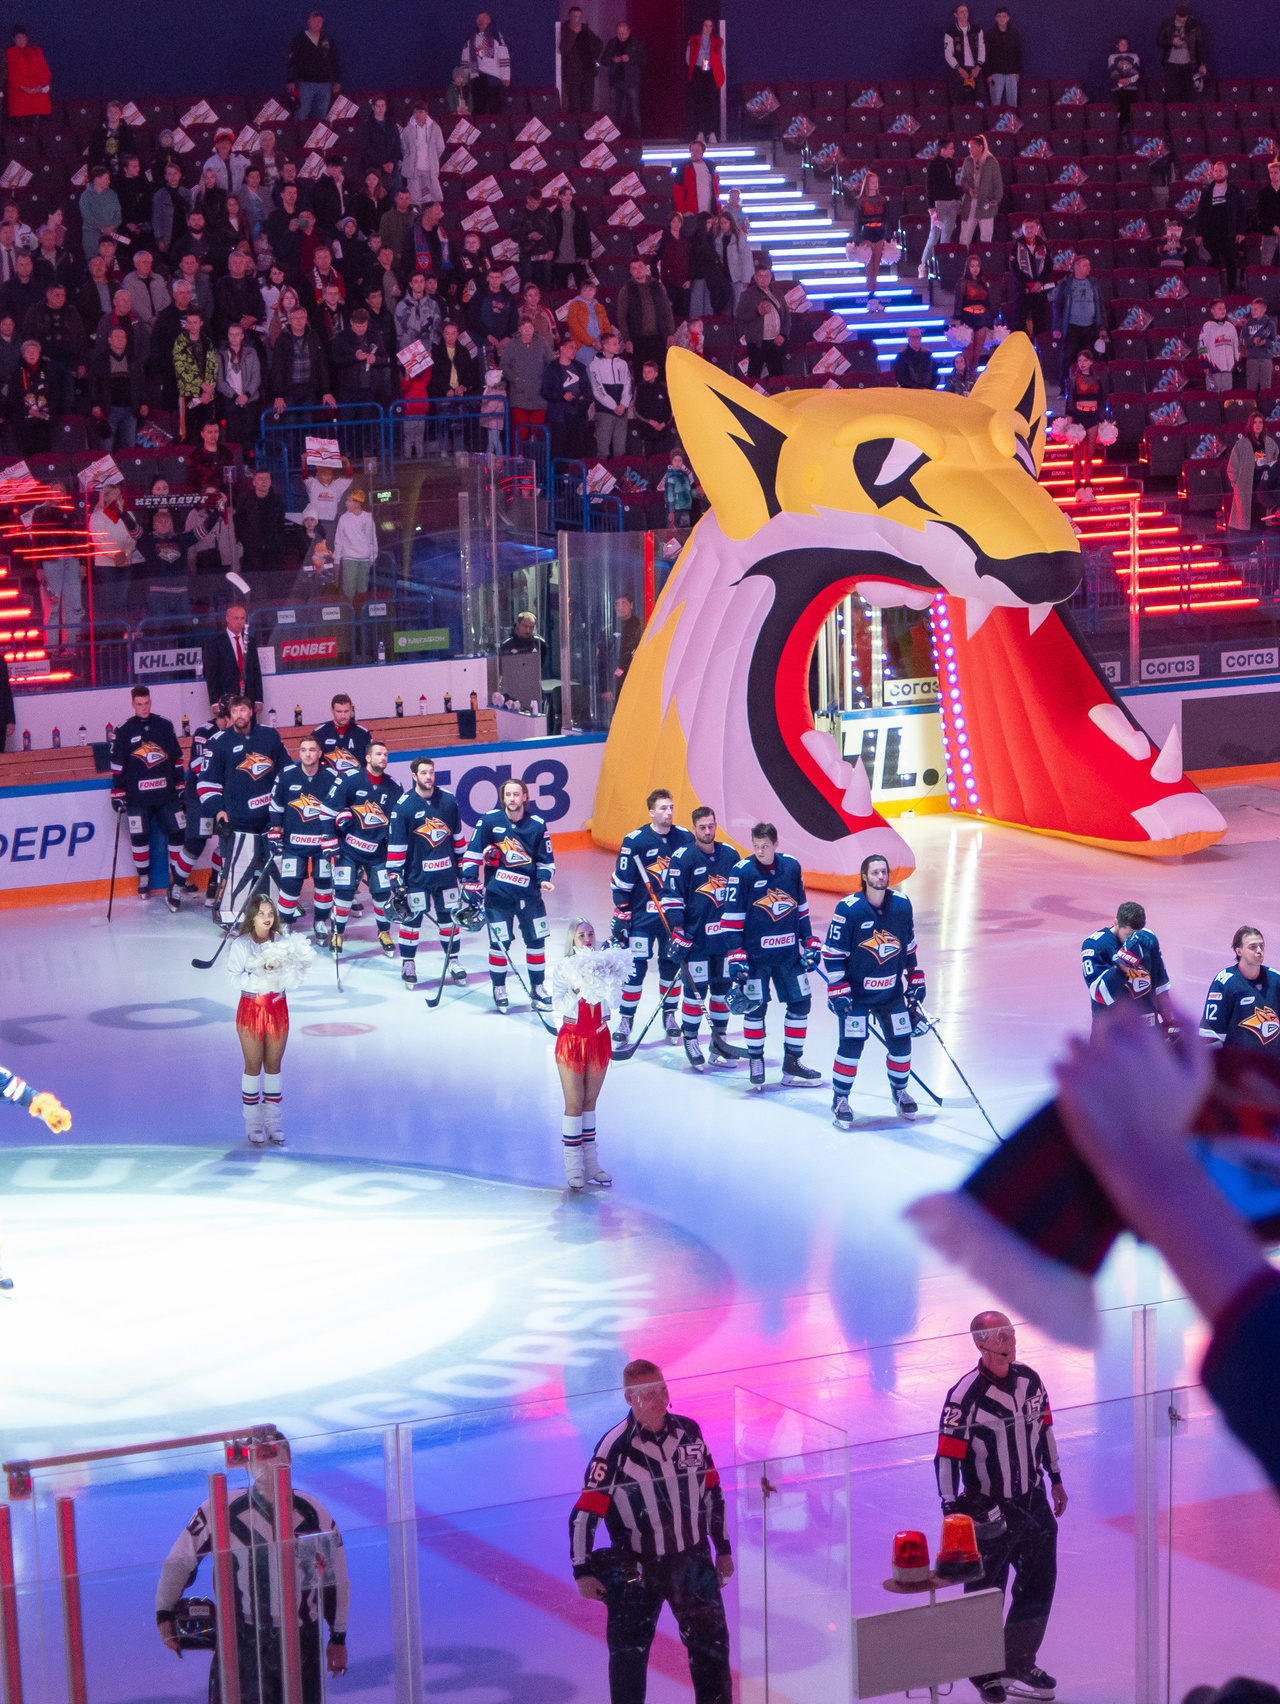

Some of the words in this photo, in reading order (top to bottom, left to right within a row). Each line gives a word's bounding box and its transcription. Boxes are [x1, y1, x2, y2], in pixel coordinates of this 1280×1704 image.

[282, 642, 335, 657] FONBET
[139, 652, 198, 669] KHL.RU
[348, 738, 354, 749] A
[140, 780, 167, 790] FONBET
[250, 797, 272, 808] FONB
[381, 793, 388, 805] C
[291, 836, 322, 844] FONBET
[346, 835, 378, 850] FONBET
[620, 856, 628, 870] 8
[497, 873, 528, 885] FONBET
[763, 935, 795, 947] FONBET
[1205, 1003, 1218, 1021] 12
